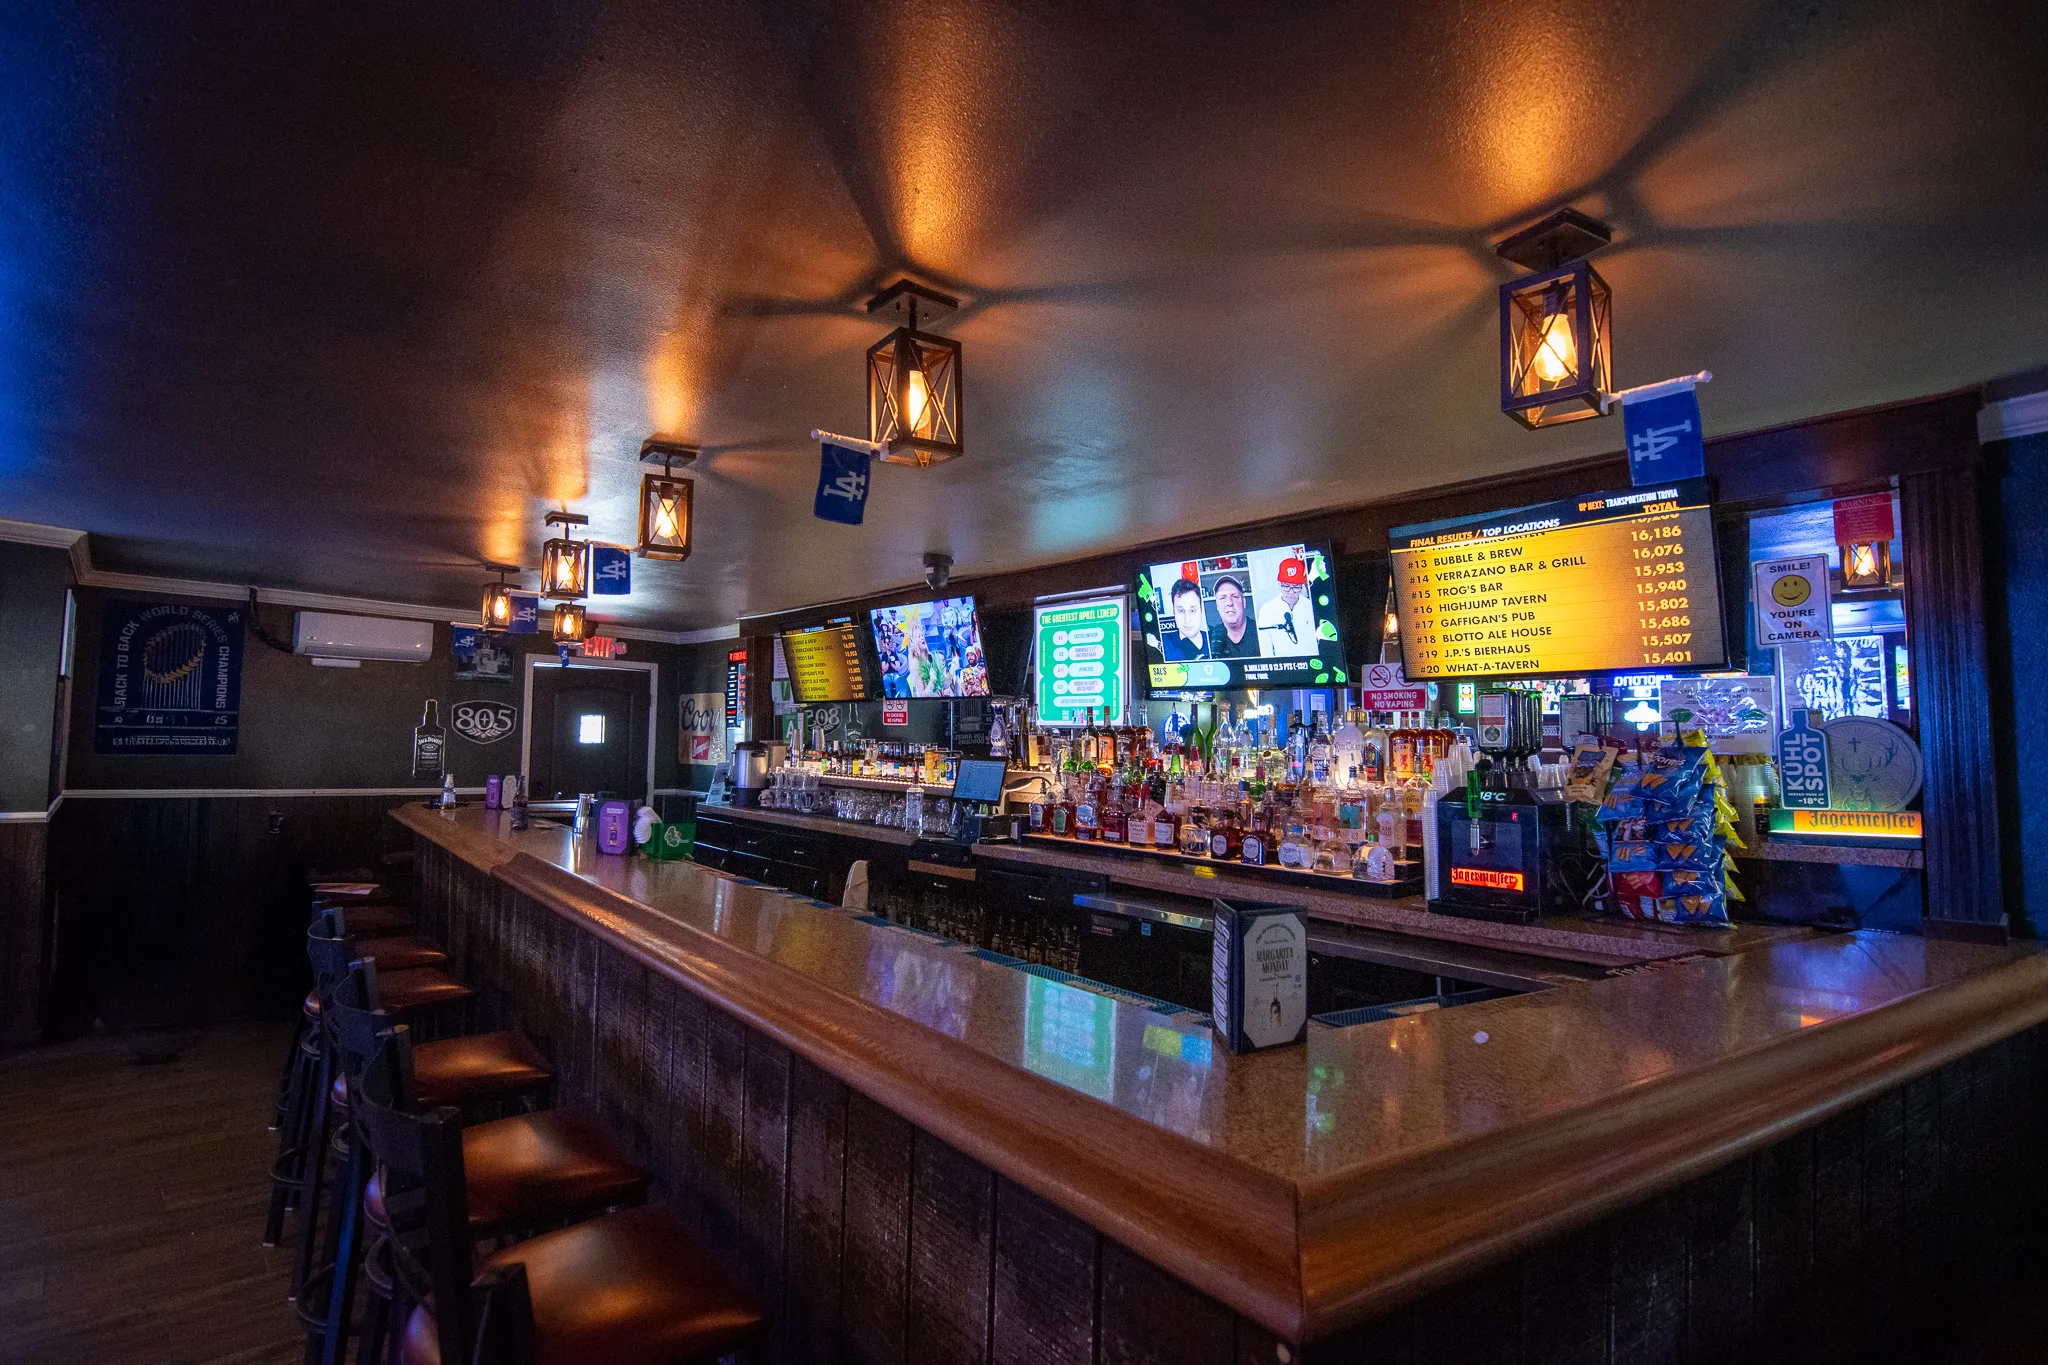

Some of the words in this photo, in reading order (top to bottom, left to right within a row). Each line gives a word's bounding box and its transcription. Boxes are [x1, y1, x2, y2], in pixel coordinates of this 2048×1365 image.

[1578, 503, 1587, 512] UP
[1588, 500, 1604, 511] NEXT:
[1605, 492, 1657, 508] TRANSPORTATION
[1657, 488, 1678, 500] TRIVIA
[1643, 501, 1680, 513] TOTAL
[1410, 537, 1435, 548] FINAL
[1437, 531, 1473, 545] RESULTS
[1482, 526, 1502, 538] TOP
[1503, 518, 1560, 535] LOCATIONS
[1408, 560, 1428, 569] #13
[1434, 553, 1473, 566] BUBBLE
[1477, 552, 1486, 561] &
[1490, 547, 1523, 559] BREW
[1631, 525, 1682, 542] 16,186
[1410, 574, 1429, 584] #14
[1435, 566, 1505, 582] VERRAZANO
[1510, 562, 1533, 573] BAR
[1538, 561, 1547, 570] &
[1552, 556, 1586, 568] GRILL
[1633, 543, 1684, 559] 16,076
[1770, 562, 1810, 573] SMILE!
[1411, 590, 1431, 599] #15
[1437, 585, 1476, 597] TROG'S
[1480, 582, 1503, 593] BAR
[1634, 561, 1685, 577] 15,953
[1413, 605, 1433, 614] #16
[1439, 599, 1498, 612] HIGHJUMP
[1502, 594, 1547, 606] TAVERN
[1636, 579, 1687, 594] 15,940
[1415, 620, 1434, 630] #17
[1441, 614, 1508, 628] GAFFIGAN'S
[1512, 611, 1535, 621] PUB
[1638, 597, 1689, 612] 15,802
[1770, 608, 1815, 619] YOU'RE
[1417, 635, 1436, 644] #18
[1443, 631, 1484, 643] BLOTTO
[1488, 629, 1507, 639] ALE
[1511, 626, 1552, 637] HOUSE
[1640, 615, 1690, 629] 15,686
[1768, 630, 1821, 641] CAMERA
[117, 620, 140, 654] BACK
[139, 605, 189, 623] WORLD
[191, 610, 228, 643] SERIES
[215, 646, 230, 709] CHAMPIONS
[584, 636, 613, 658] EXIT
[1419, 650, 1438, 659] #19
[1445, 648, 1470, 658] J.P.'S
[1474, 644, 1531, 656] BIERHAUS
[1642, 633, 1692, 647] 15,507
[1153, 666, 1167, 675] SAL'S
[1421, 664, 1440, 674] #20
[1445, 660, 1539, 673] WHAT-A-TAVERN
[1643, 651, 1692, 664] 15,401
[1371, 692, 1381, 700] NO
[1383, 691, 1417, 700] SMOKING
[1385, 700, 1414, 708] VAPING
[456, 707, 512, 731] 805
[1782, 733, 1804, 790] KÜHL
[1802, 733, 1824, 791] SPOT
[1798, 797, 1824, 805] -18°C
[1256, 947, 1295, 962] MARGARITA
[1262, 960, 1289, 973] MONDAY
